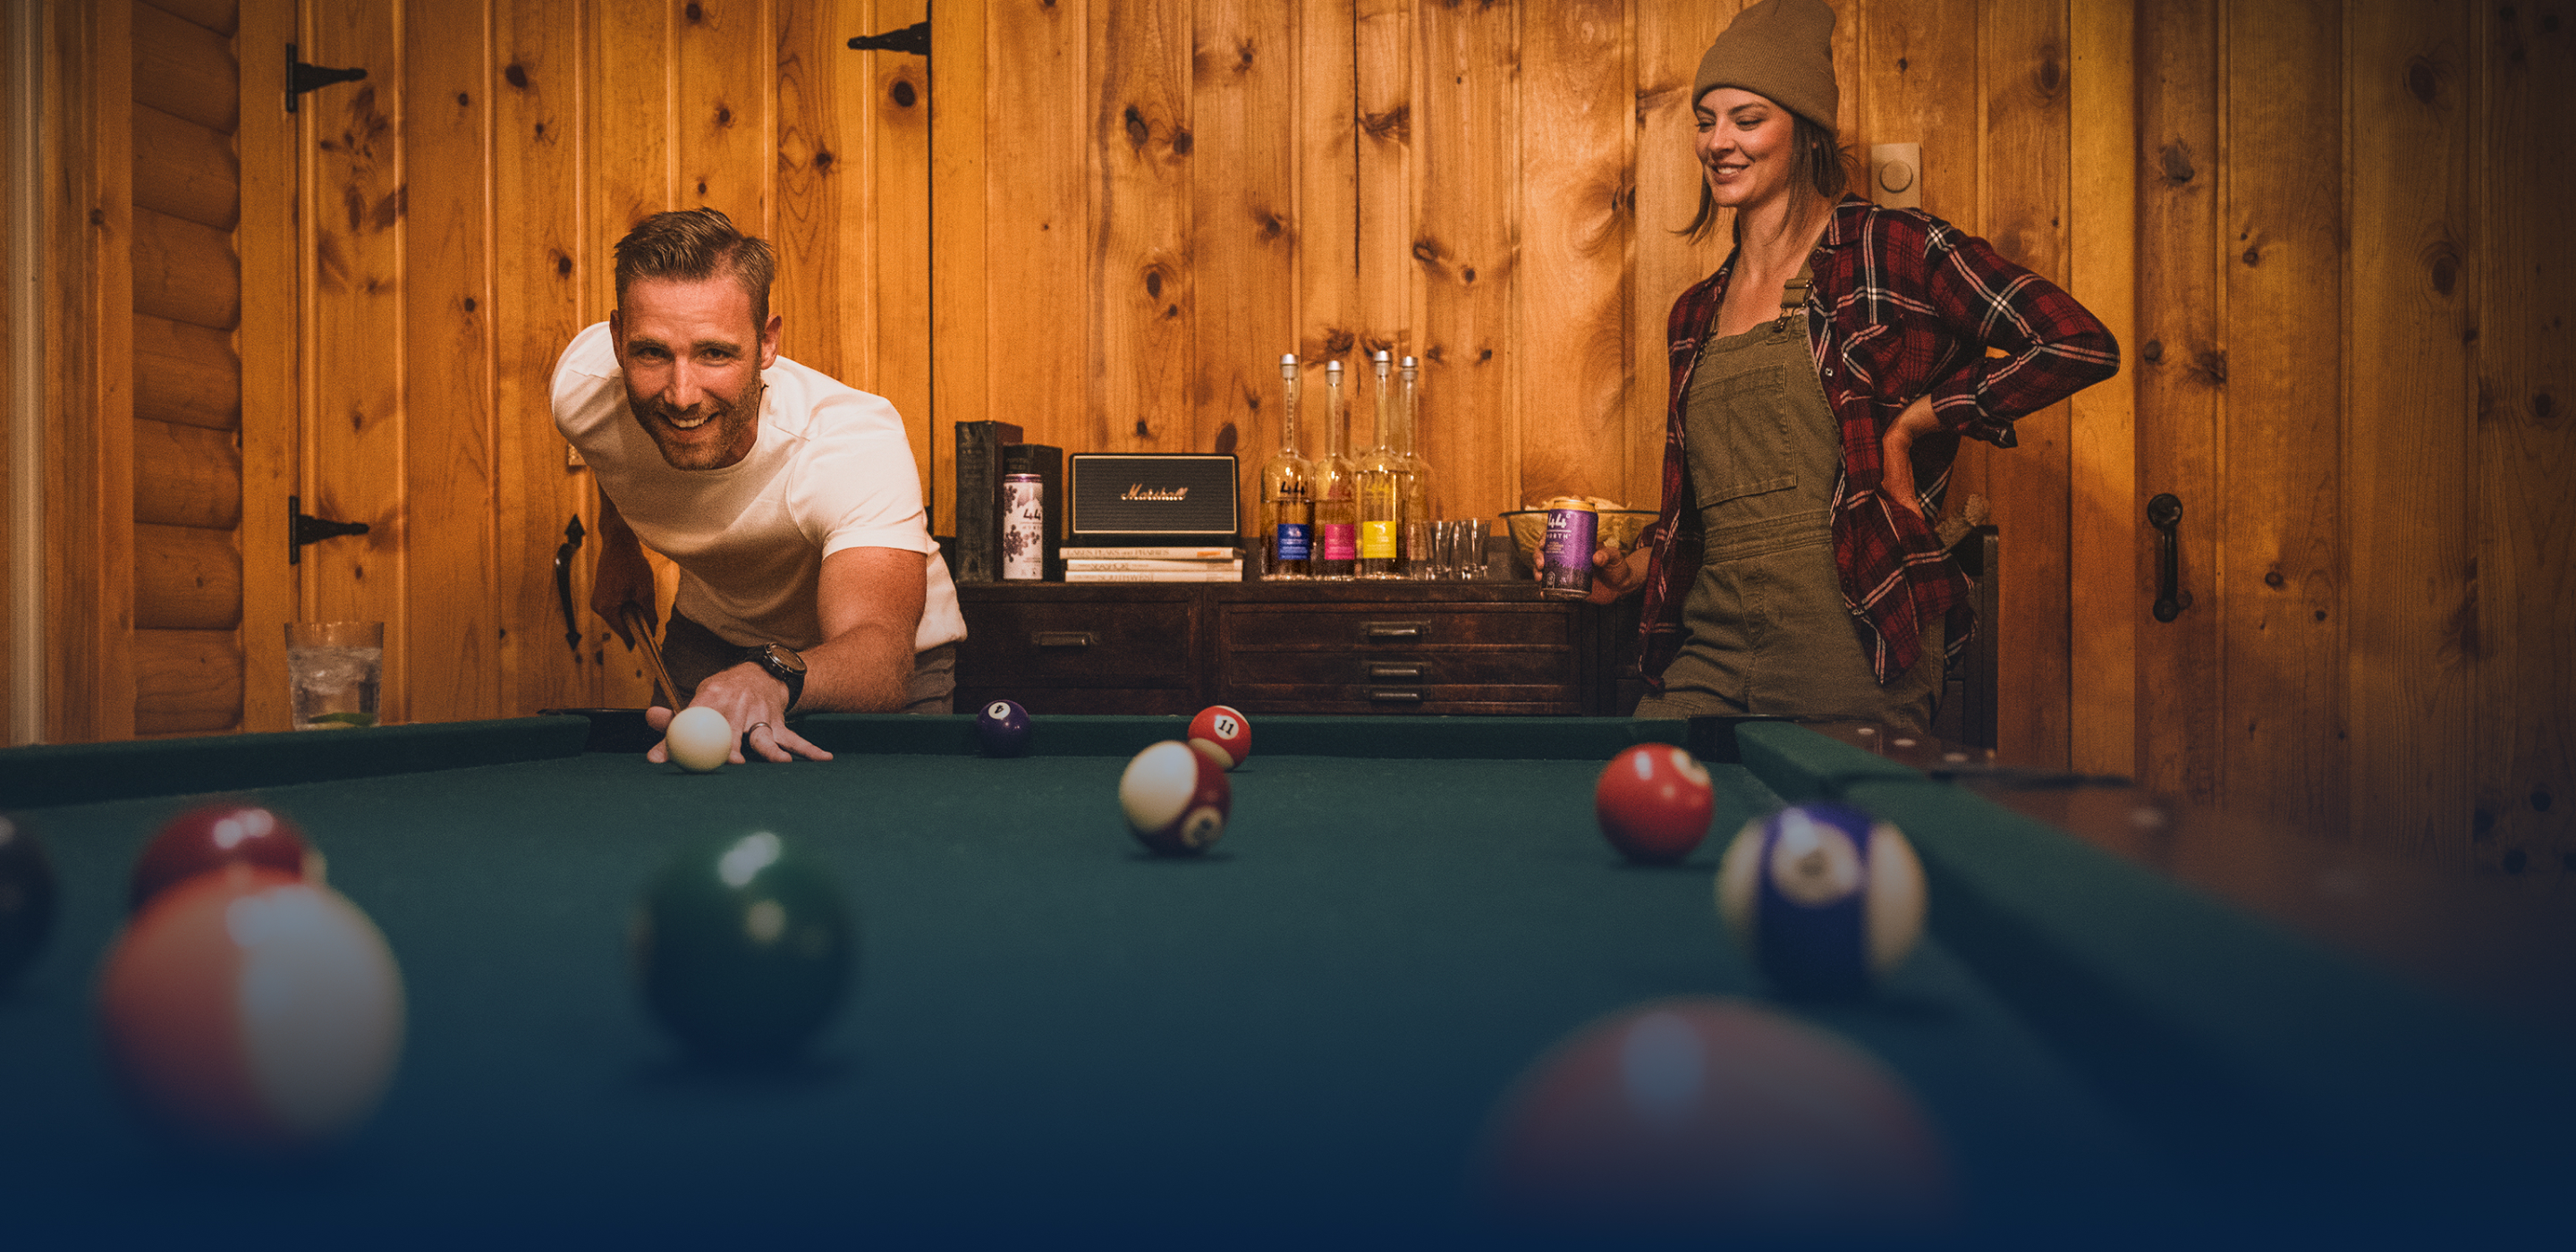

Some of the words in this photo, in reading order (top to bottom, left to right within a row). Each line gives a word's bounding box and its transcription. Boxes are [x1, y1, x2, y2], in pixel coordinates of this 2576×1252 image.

[1121, 483, 1189, 501] Marshall
[1280, 481, 1305, 495] 44
[1023, 509, 1041, 520] 44
[995, 705, 1004, 714] 4
[1218, 719, 1234, 735] 11
